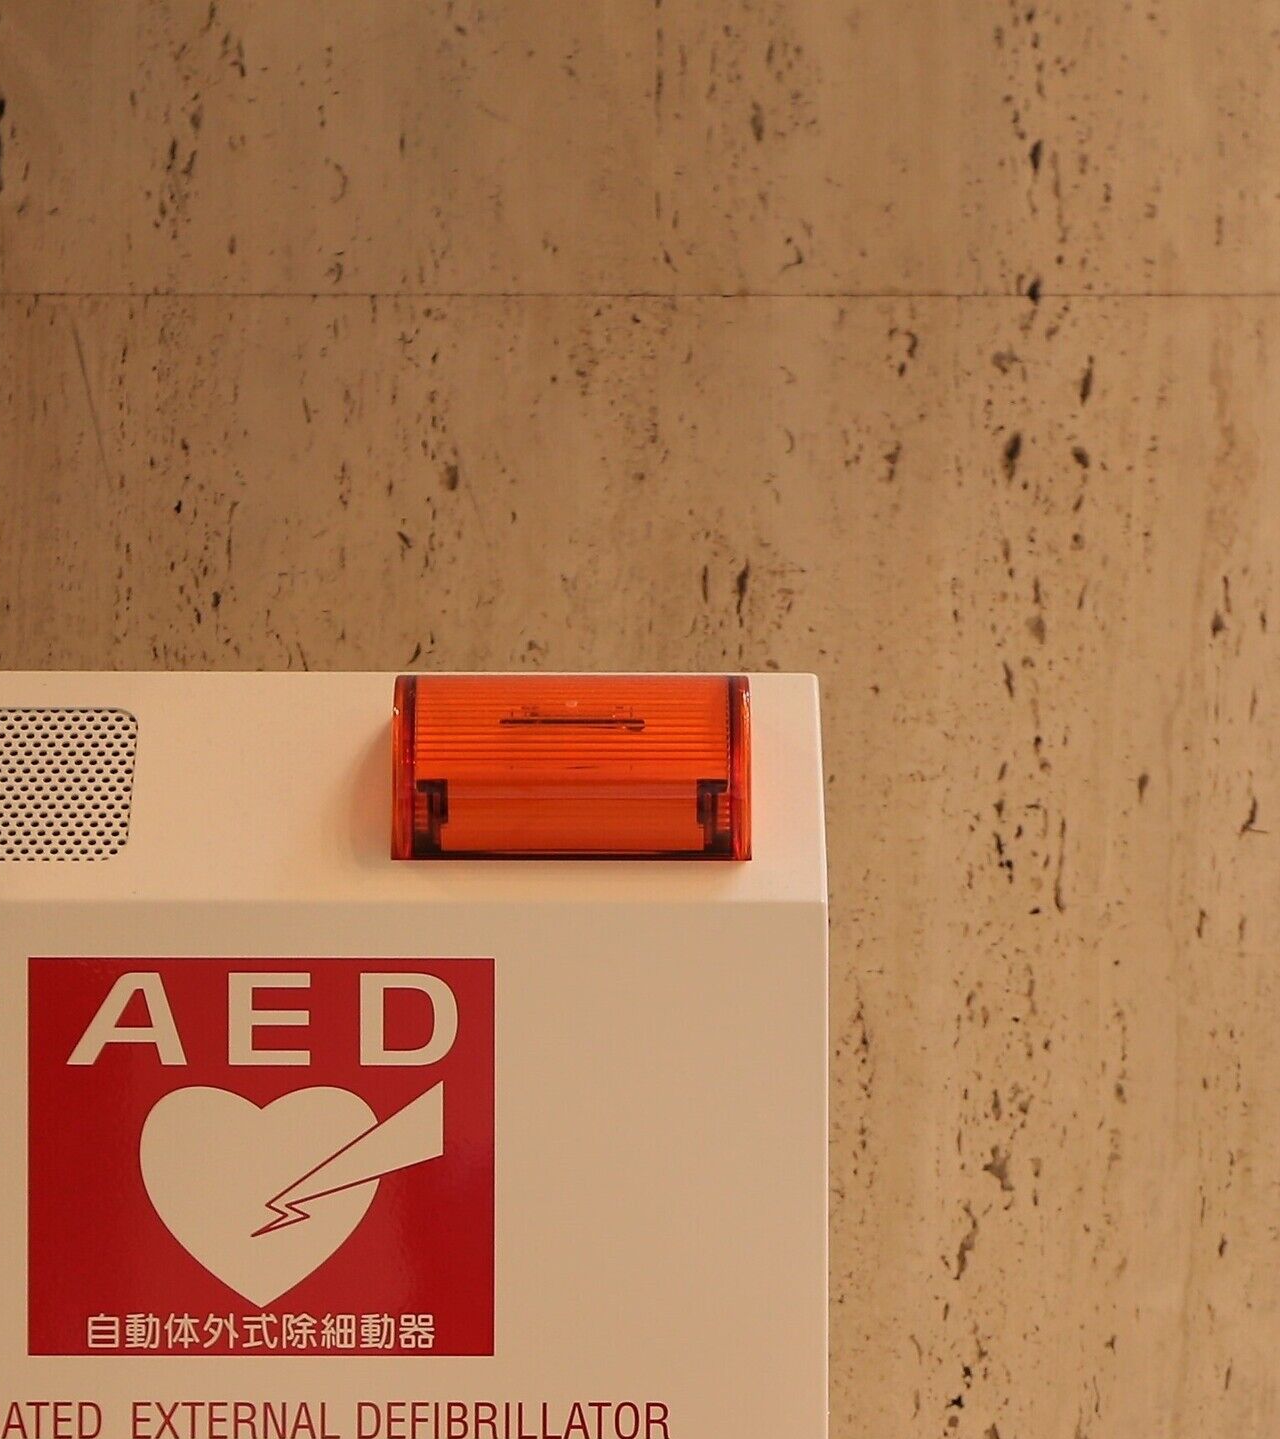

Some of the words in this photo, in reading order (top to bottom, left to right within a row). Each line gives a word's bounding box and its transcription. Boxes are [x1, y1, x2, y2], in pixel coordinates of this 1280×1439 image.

[66, 972, 459, 1067] AED
[85, 1313, 436, 1350] 自動体外式除細動器
[131, 1401, 340, 1439] EXTERNAL
